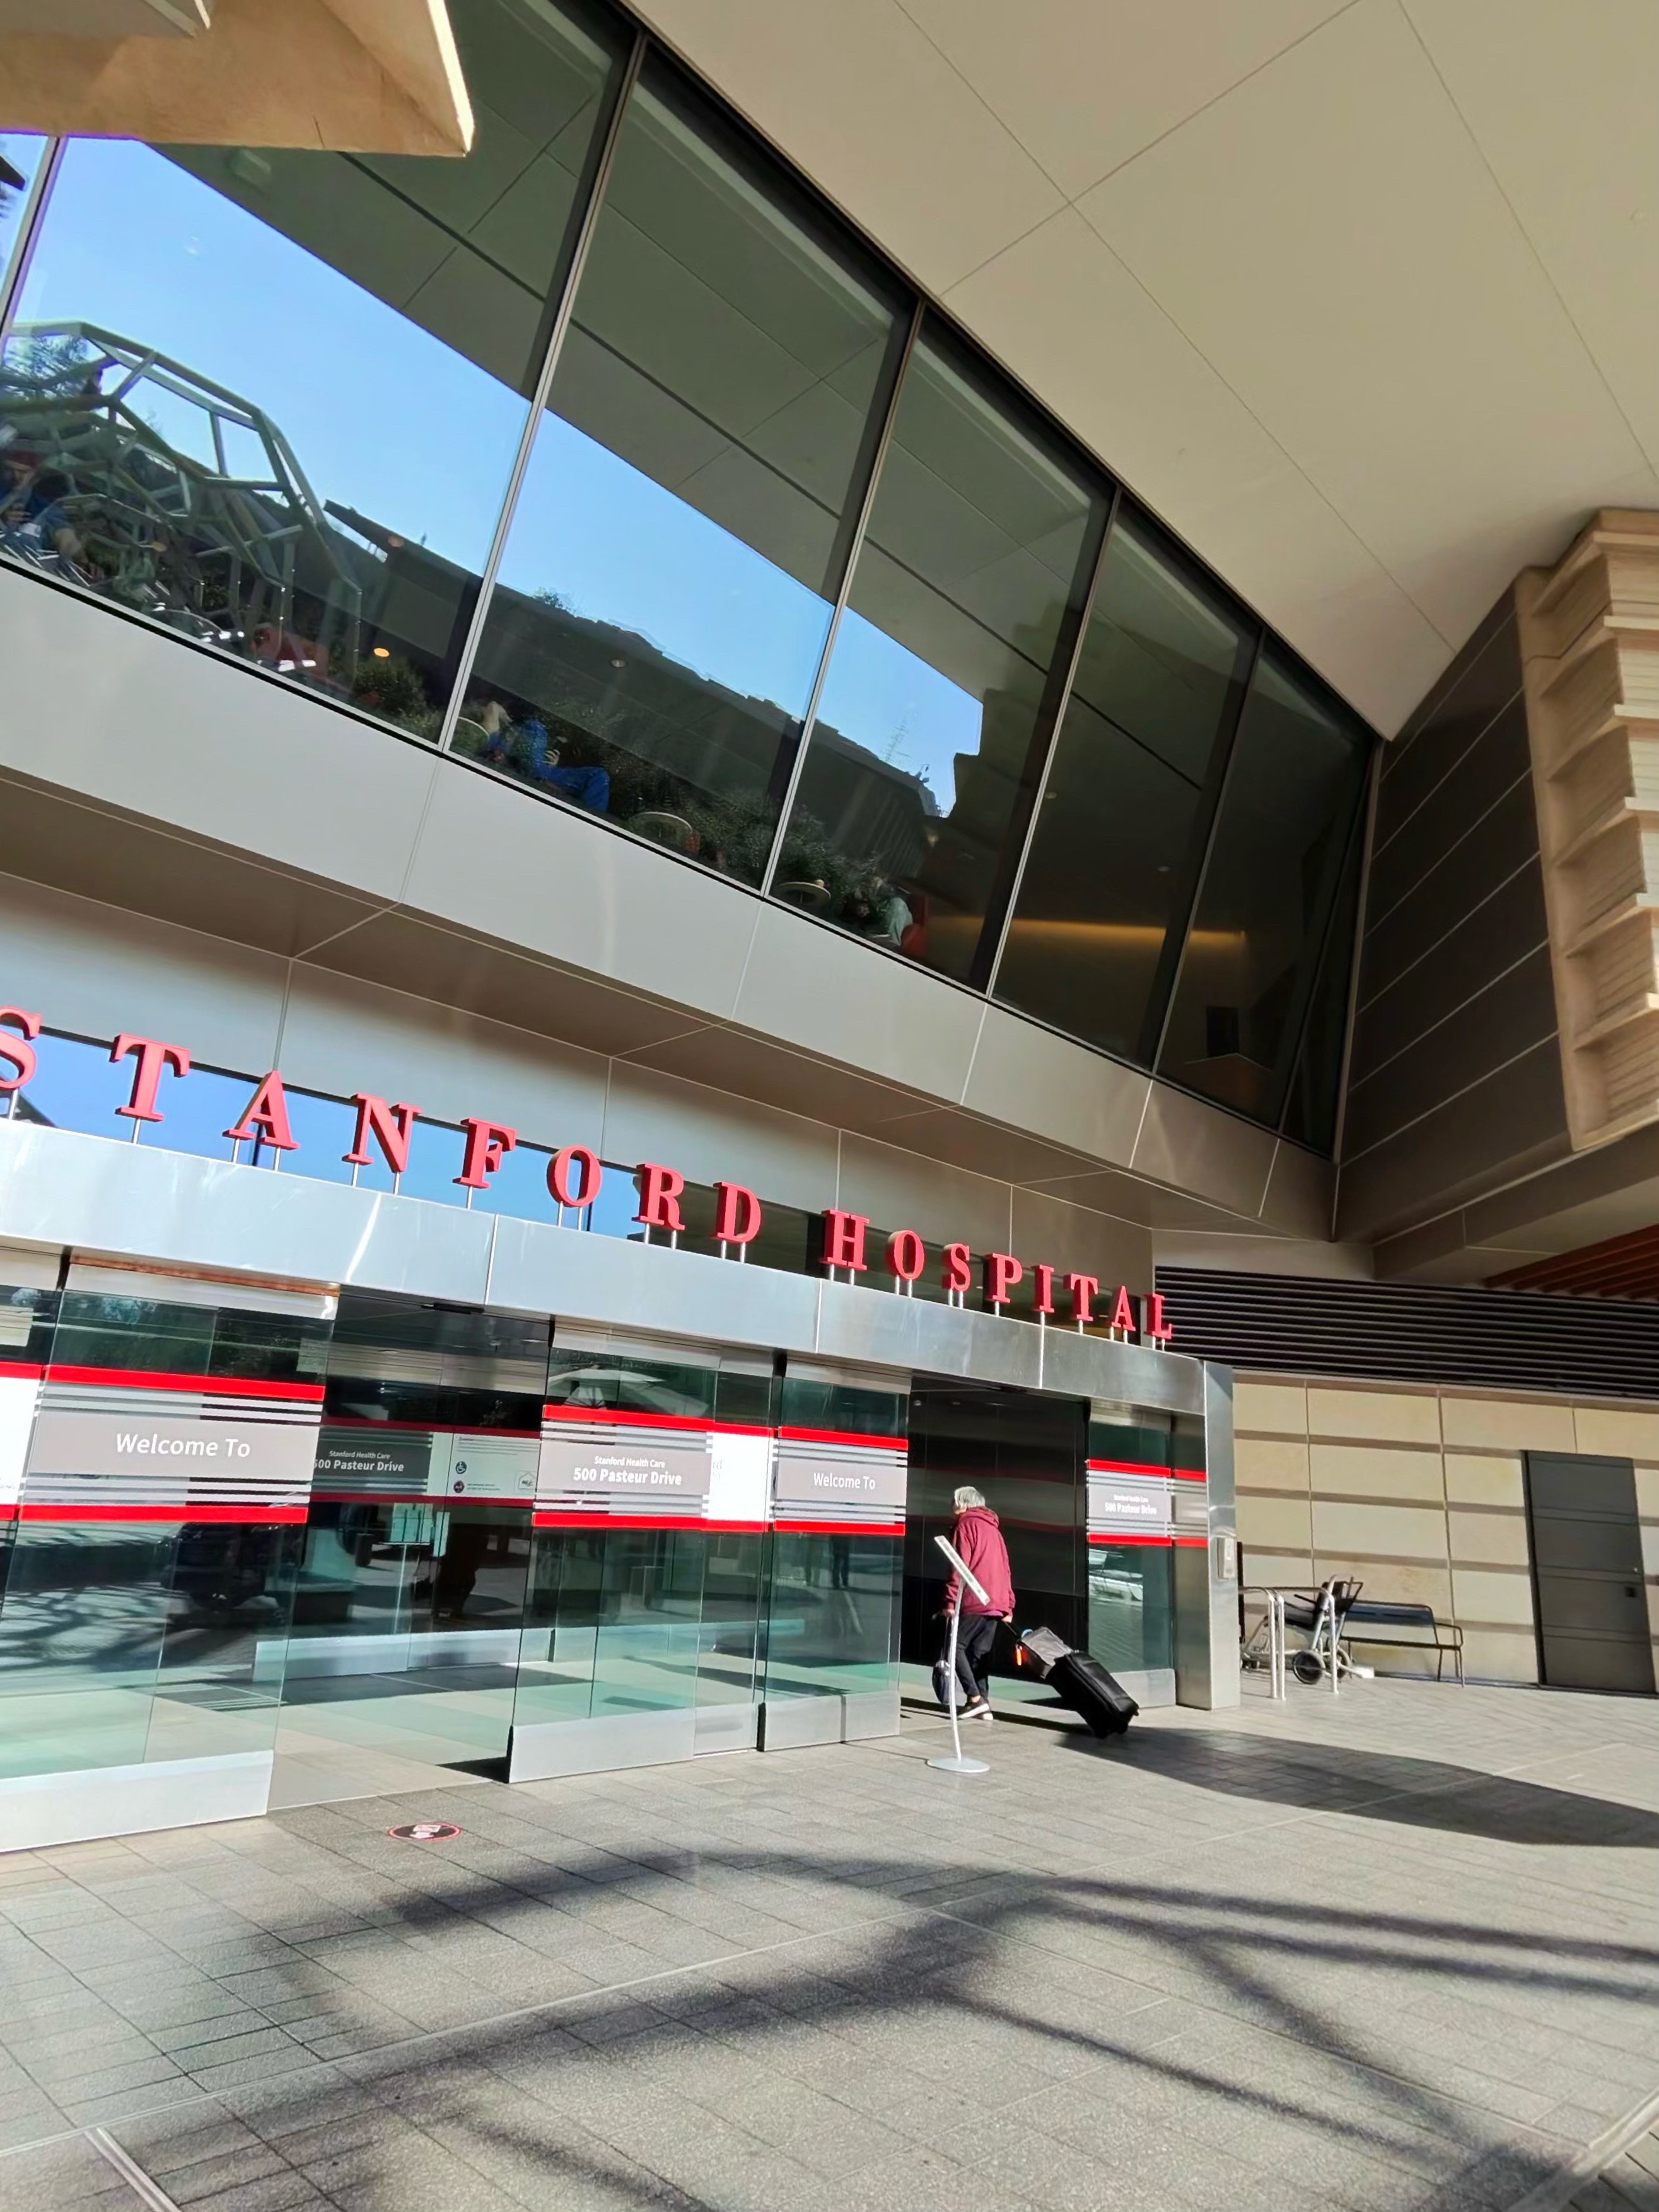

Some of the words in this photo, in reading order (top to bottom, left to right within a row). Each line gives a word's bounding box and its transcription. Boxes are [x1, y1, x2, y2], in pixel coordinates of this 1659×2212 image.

[0, 1005, 762, 1243] STANFORD
[819, 1208, 1172, 1340] HOSPITAL
[116, 1433, 219, 1456] Welcome
[224, 1438, 251, 1457] To
[329, 1450, 356, 1458] Stanford
[334, 1459, 375, 1471] Pasteur
[377, 1461, 404, 1471] Drive
[594, 1456, 626, 1466] Stanford
[626, 1457, 649, 1468] Health
[649, 1459, 666, 1468] Care
[573, 1467, 597, 1481] 500
[600, 1468, 648, 1484] Pasteur
[650, 1471, 682, 1486] Drive
[813, 1472, 861, 1488] Welcome
[863, 1476, 876, 1490] To
